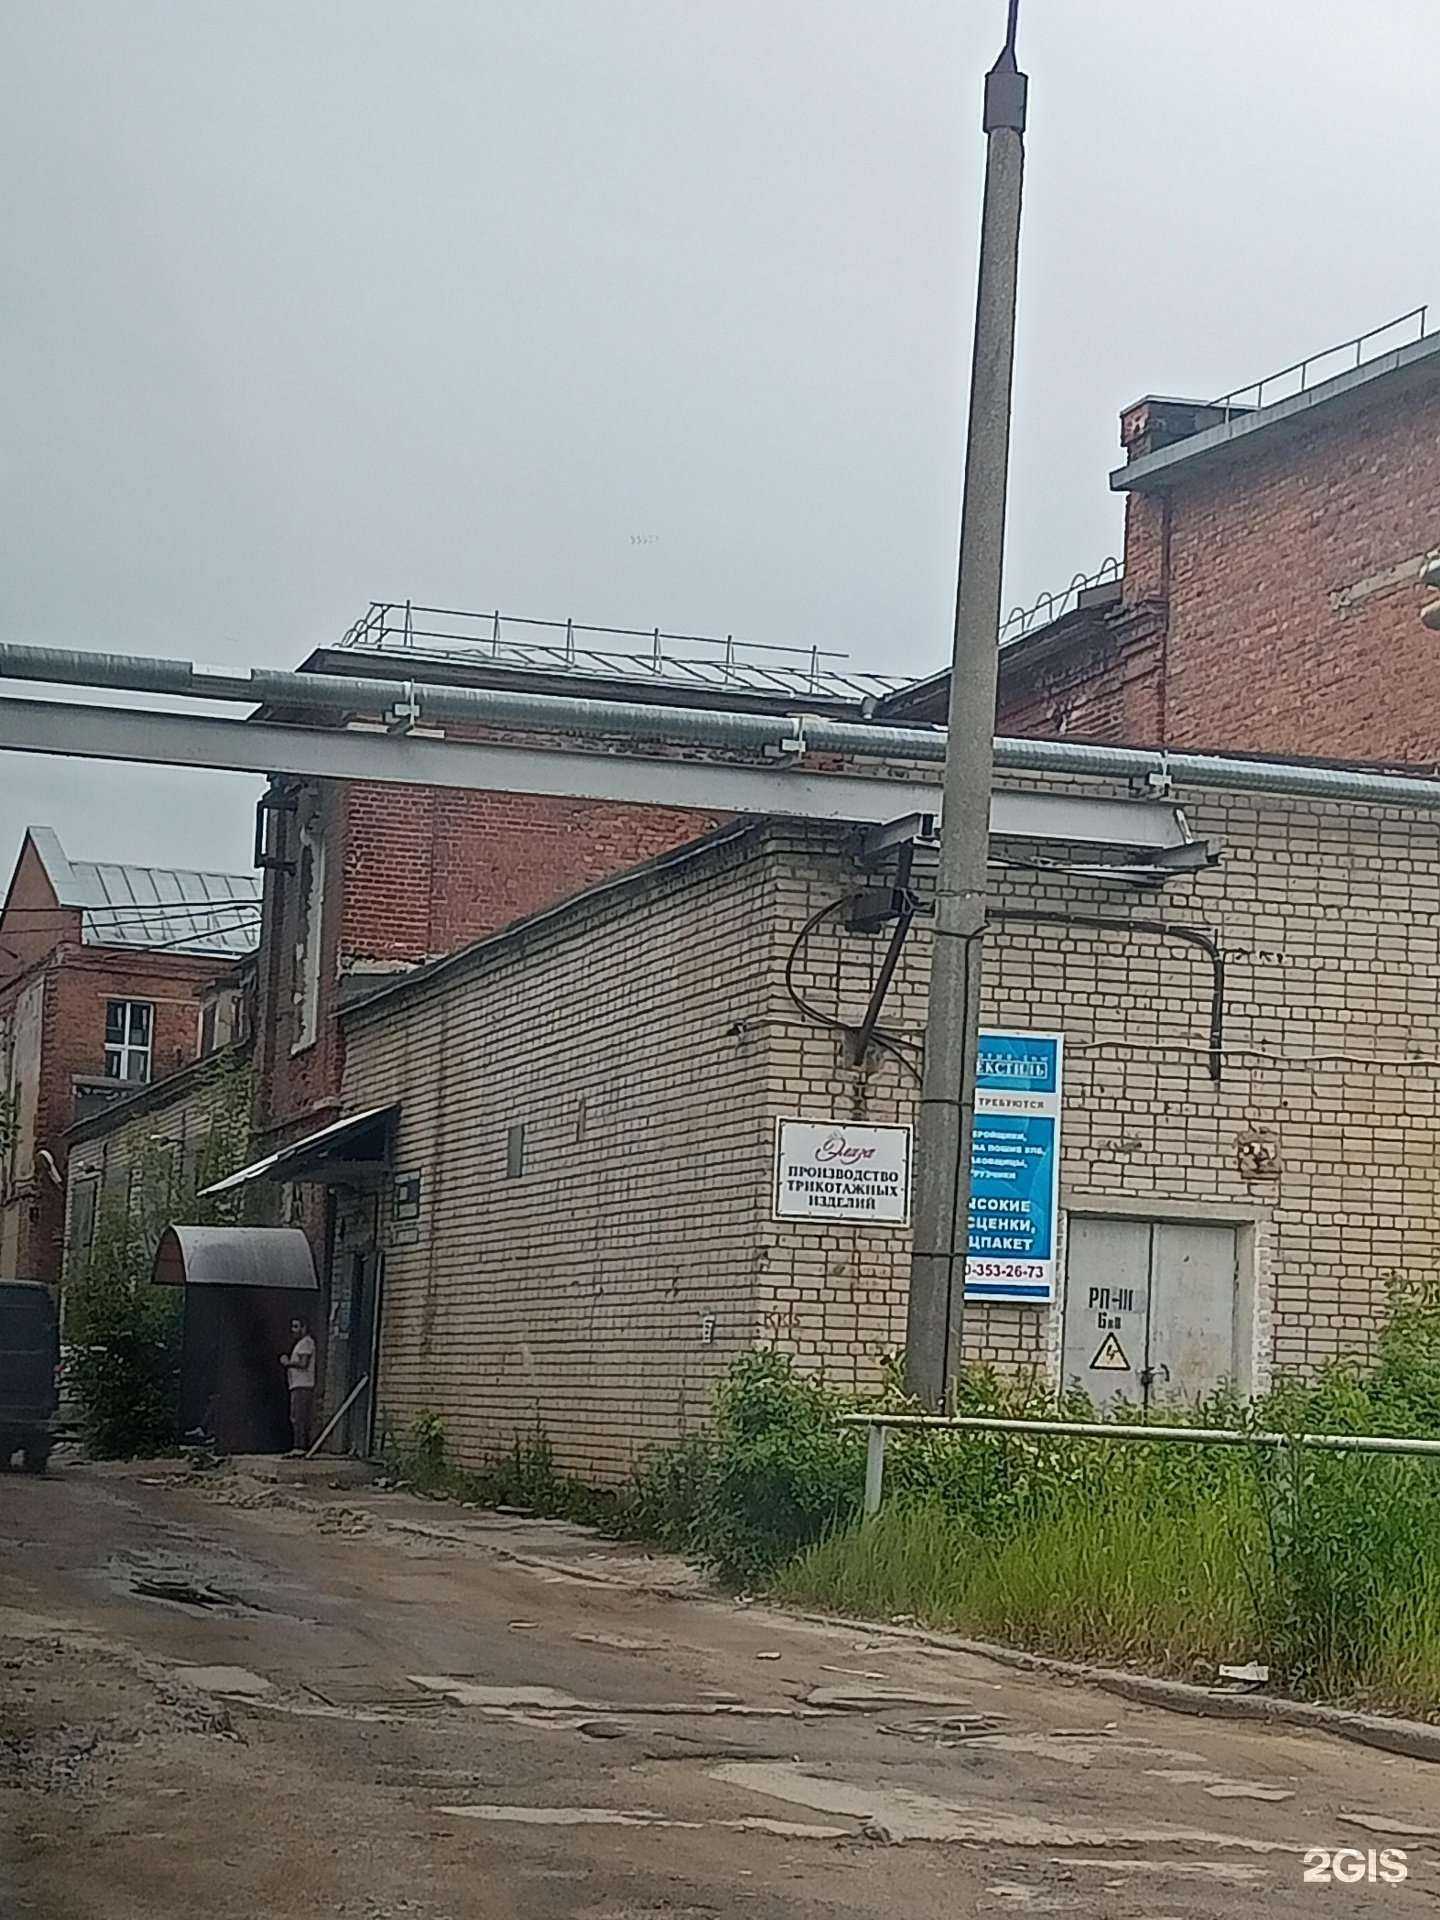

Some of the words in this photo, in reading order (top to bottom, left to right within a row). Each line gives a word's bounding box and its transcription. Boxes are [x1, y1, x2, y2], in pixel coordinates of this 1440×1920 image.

[978, 1097, 1045, 1109] ТРЕБУЮТСЯ
[788, 1166, 899, 1182] ПРОИЗВОДСТВО
[787, 1180, 898, 1197] ТРИКОТАЖНЫХ
[808, 1195, 876, 1210] ИЗДЕЛИЙ
